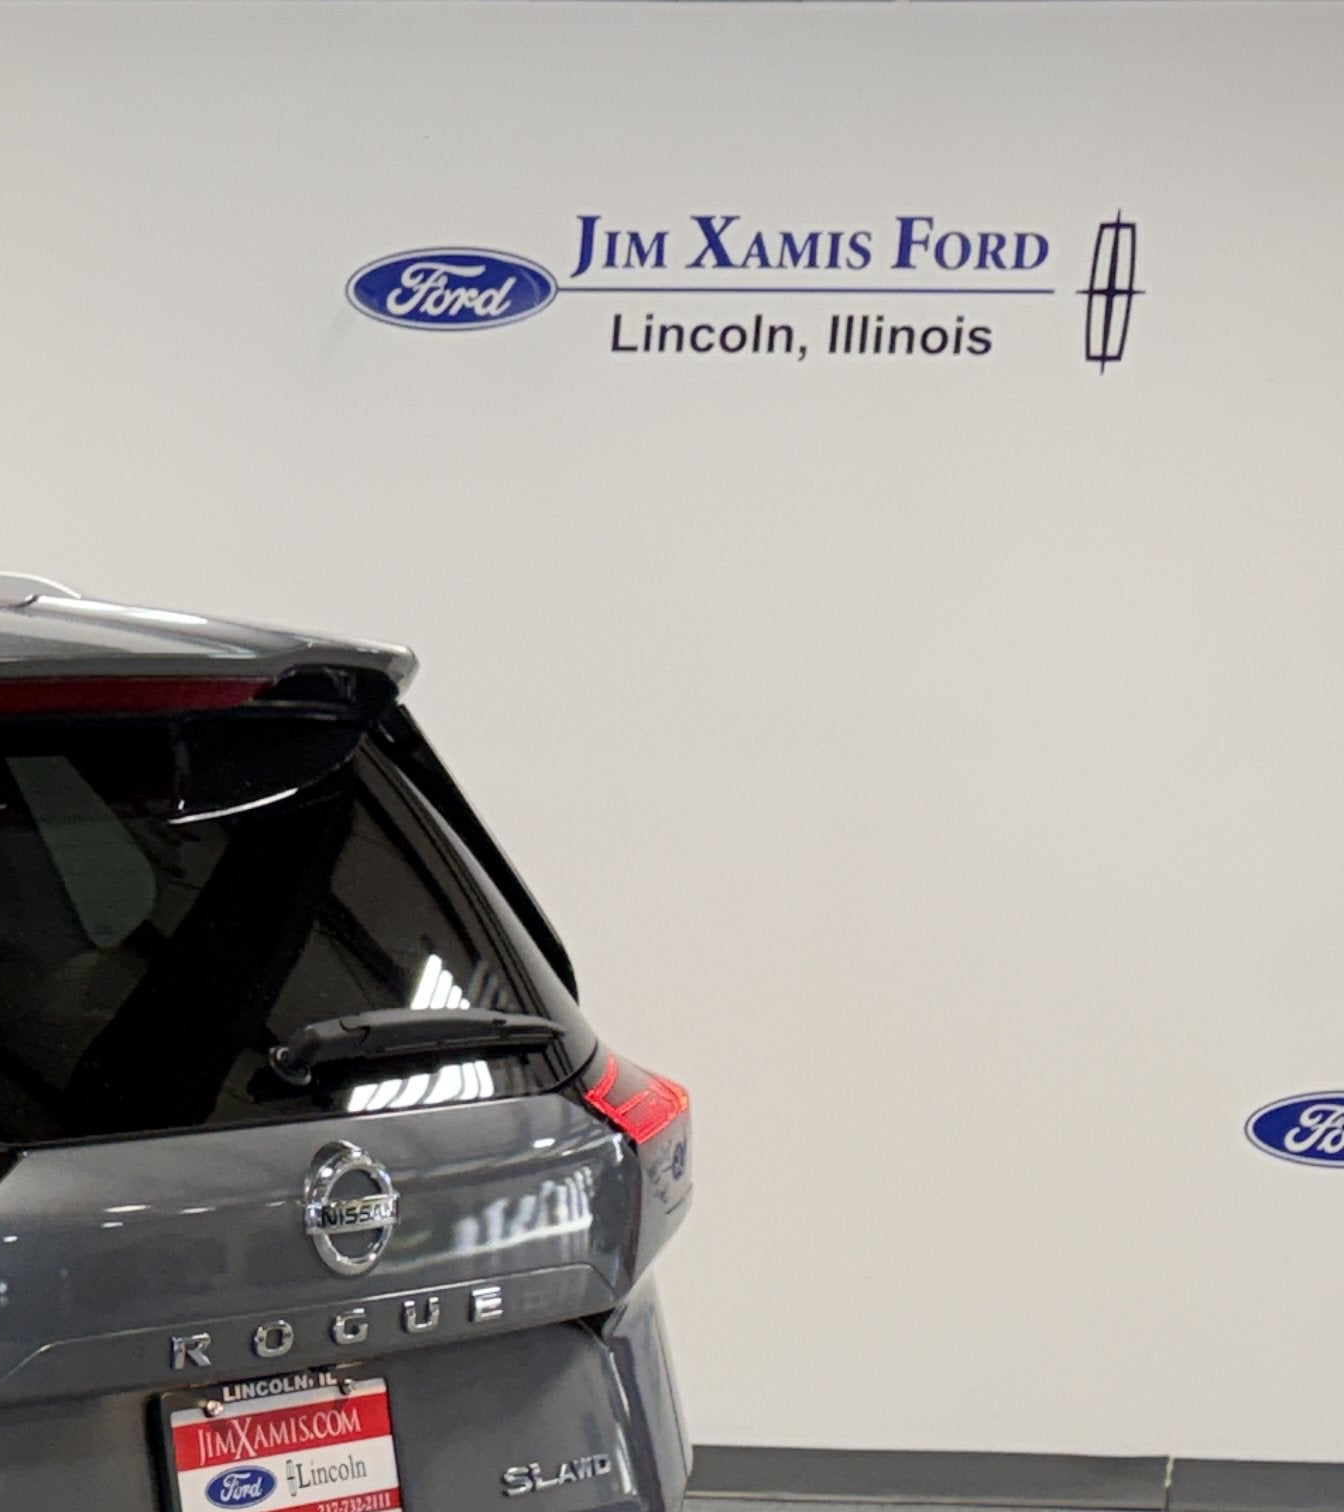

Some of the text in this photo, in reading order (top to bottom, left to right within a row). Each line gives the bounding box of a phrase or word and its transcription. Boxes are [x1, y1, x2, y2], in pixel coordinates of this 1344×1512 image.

[386, 262, 516, 316] Ford
[611, 314, 993, 362] Lincoln, Illinois
[171, 1286, 504, 1370] ROGUE
[222, 1371, 338, 1402] LINCOLN, IL
[220, 1455, 367, 1502] Ford Lincoln
